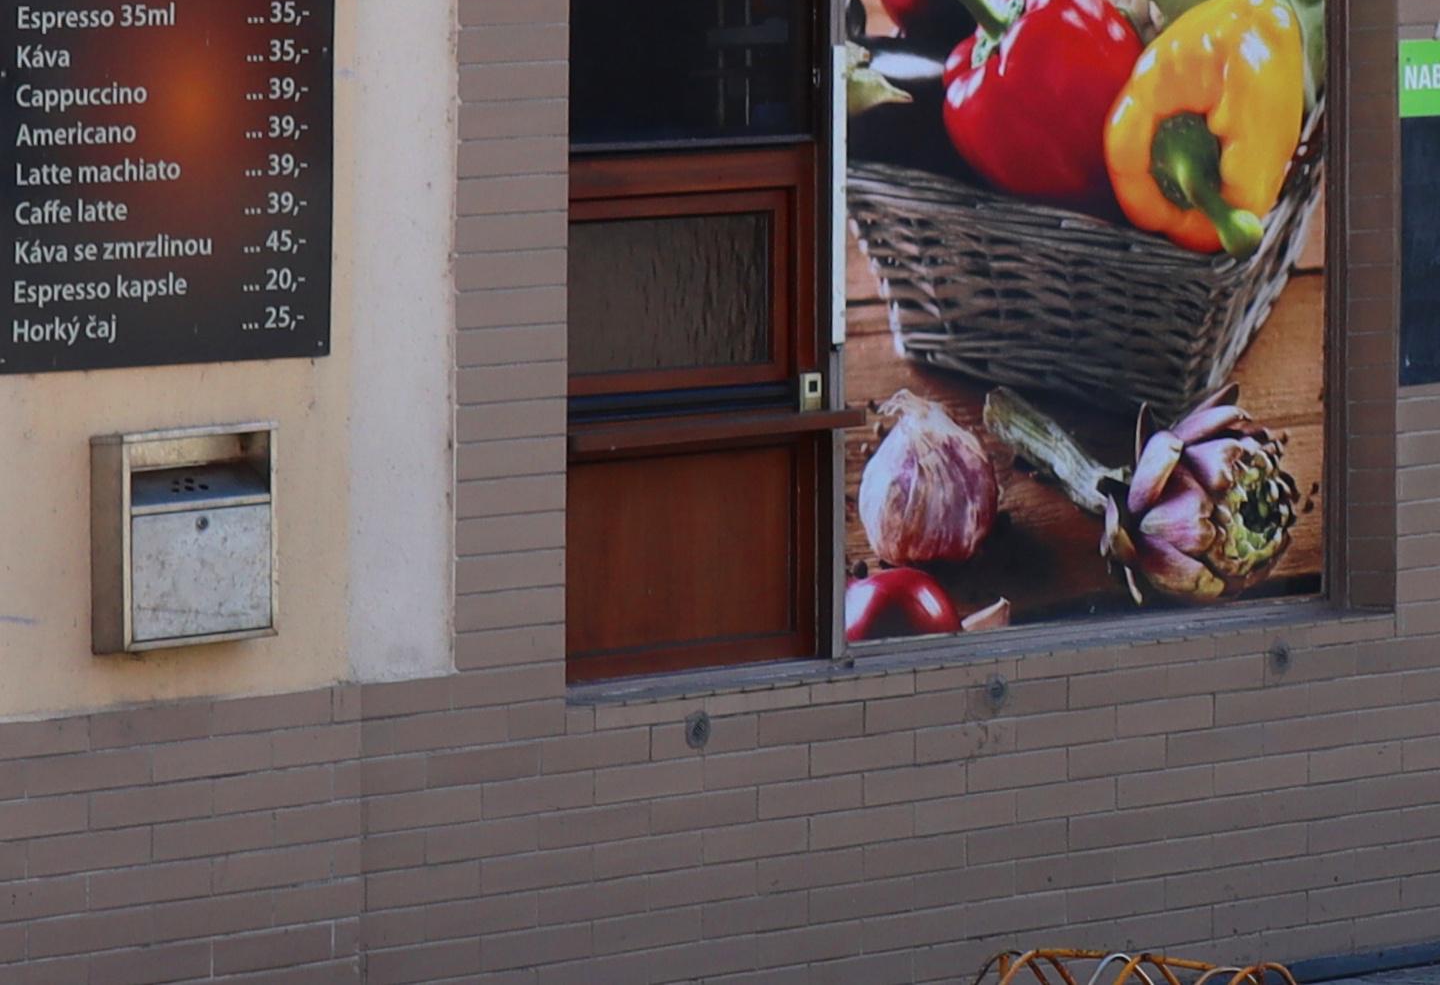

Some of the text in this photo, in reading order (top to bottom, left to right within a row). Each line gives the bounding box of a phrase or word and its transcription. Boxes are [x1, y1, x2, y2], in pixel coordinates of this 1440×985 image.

[17, 5, 114, 34] Espresso
[120, 2, 175, 27] 35ml
[17, 44, 70, 68] Káva
[16, 82, 148, 112] Cappuccino
[16, 122, 136, 146] Americano
[16, 162, 72, 186] Latte
[79, 158, 181, 184] machiato
[15, 200, 72, 225] Caffe
[78, 198, 128, 223] latte
[14, 239, 68, 264] Káva
[74, 243, 98, 261] se
[103, 234, 213, 260] zmrzlinou
[13, 279, 111, 308] Espresso
[117, 271, 187, 302] kapsle
[13, 315, 80, 345] Horký
[86, 314, 117, 343] čaj
